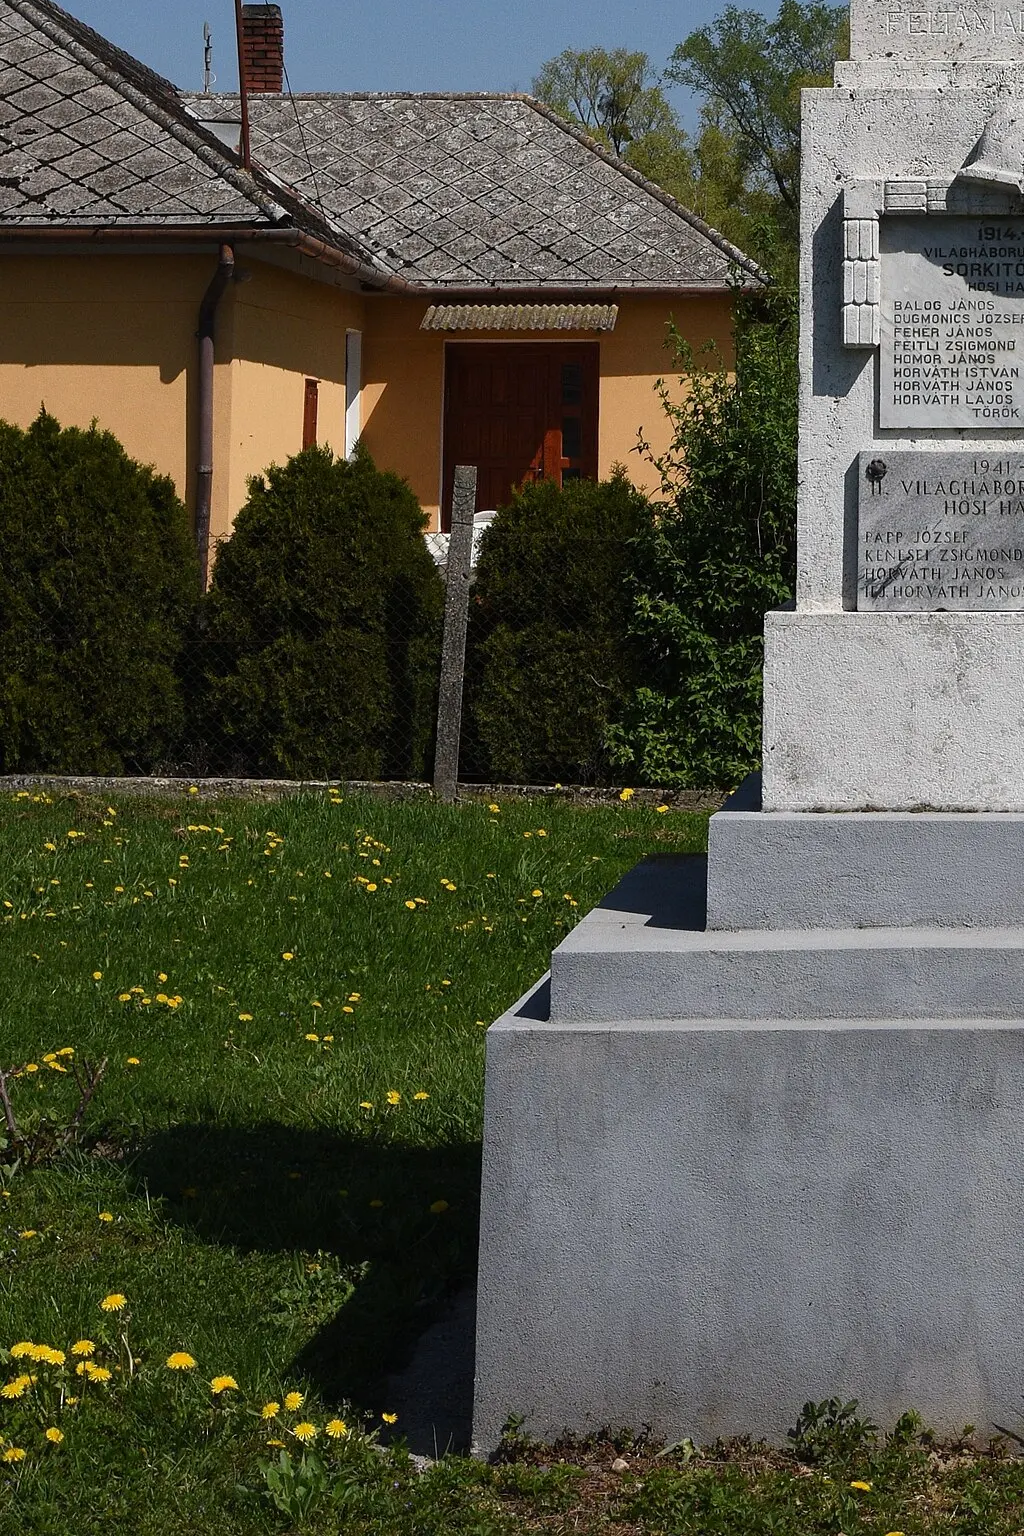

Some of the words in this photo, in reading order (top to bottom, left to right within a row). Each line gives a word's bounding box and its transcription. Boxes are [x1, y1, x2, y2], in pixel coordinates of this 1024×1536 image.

[894, 301, 941, 311] BALOG
[948, 298, 995, 311] JÁNOS
[894, 314, 970, 324] DUGMONICS
[894, 325, 940, 337] FEHÉR
[946, 325, 993, 337] JÁNOS
[894, 341, 939, 351] FEITLI
[945, 340, 1016, 351] ZSIGMOND
[894, 354, 941, 364] HOMOR
[948, 351, 995, 364] JÁNOS
[894, 365, 960, 378] HORVÁTH
[965, 365, 1019, 378] ISTVÁN
[894, 378, 960, 391] HORVÁTH
[966, 378, 1013, 391] JÁNOS
[894, 392, 960, 405] HORVÁTH
[965, 395, 1013, 405] LAJOS
[972, 405, 1020, 418] TÖRÖK
[973, 460, 1010, 475] 1941
[865, 531, 903, 543] PAPP
[913, 526, 970, 543] JÓZSEF
[940, 549, 1023, 561] ZSIGMOND
[865, 563, 941, 580] HORVÁTH
